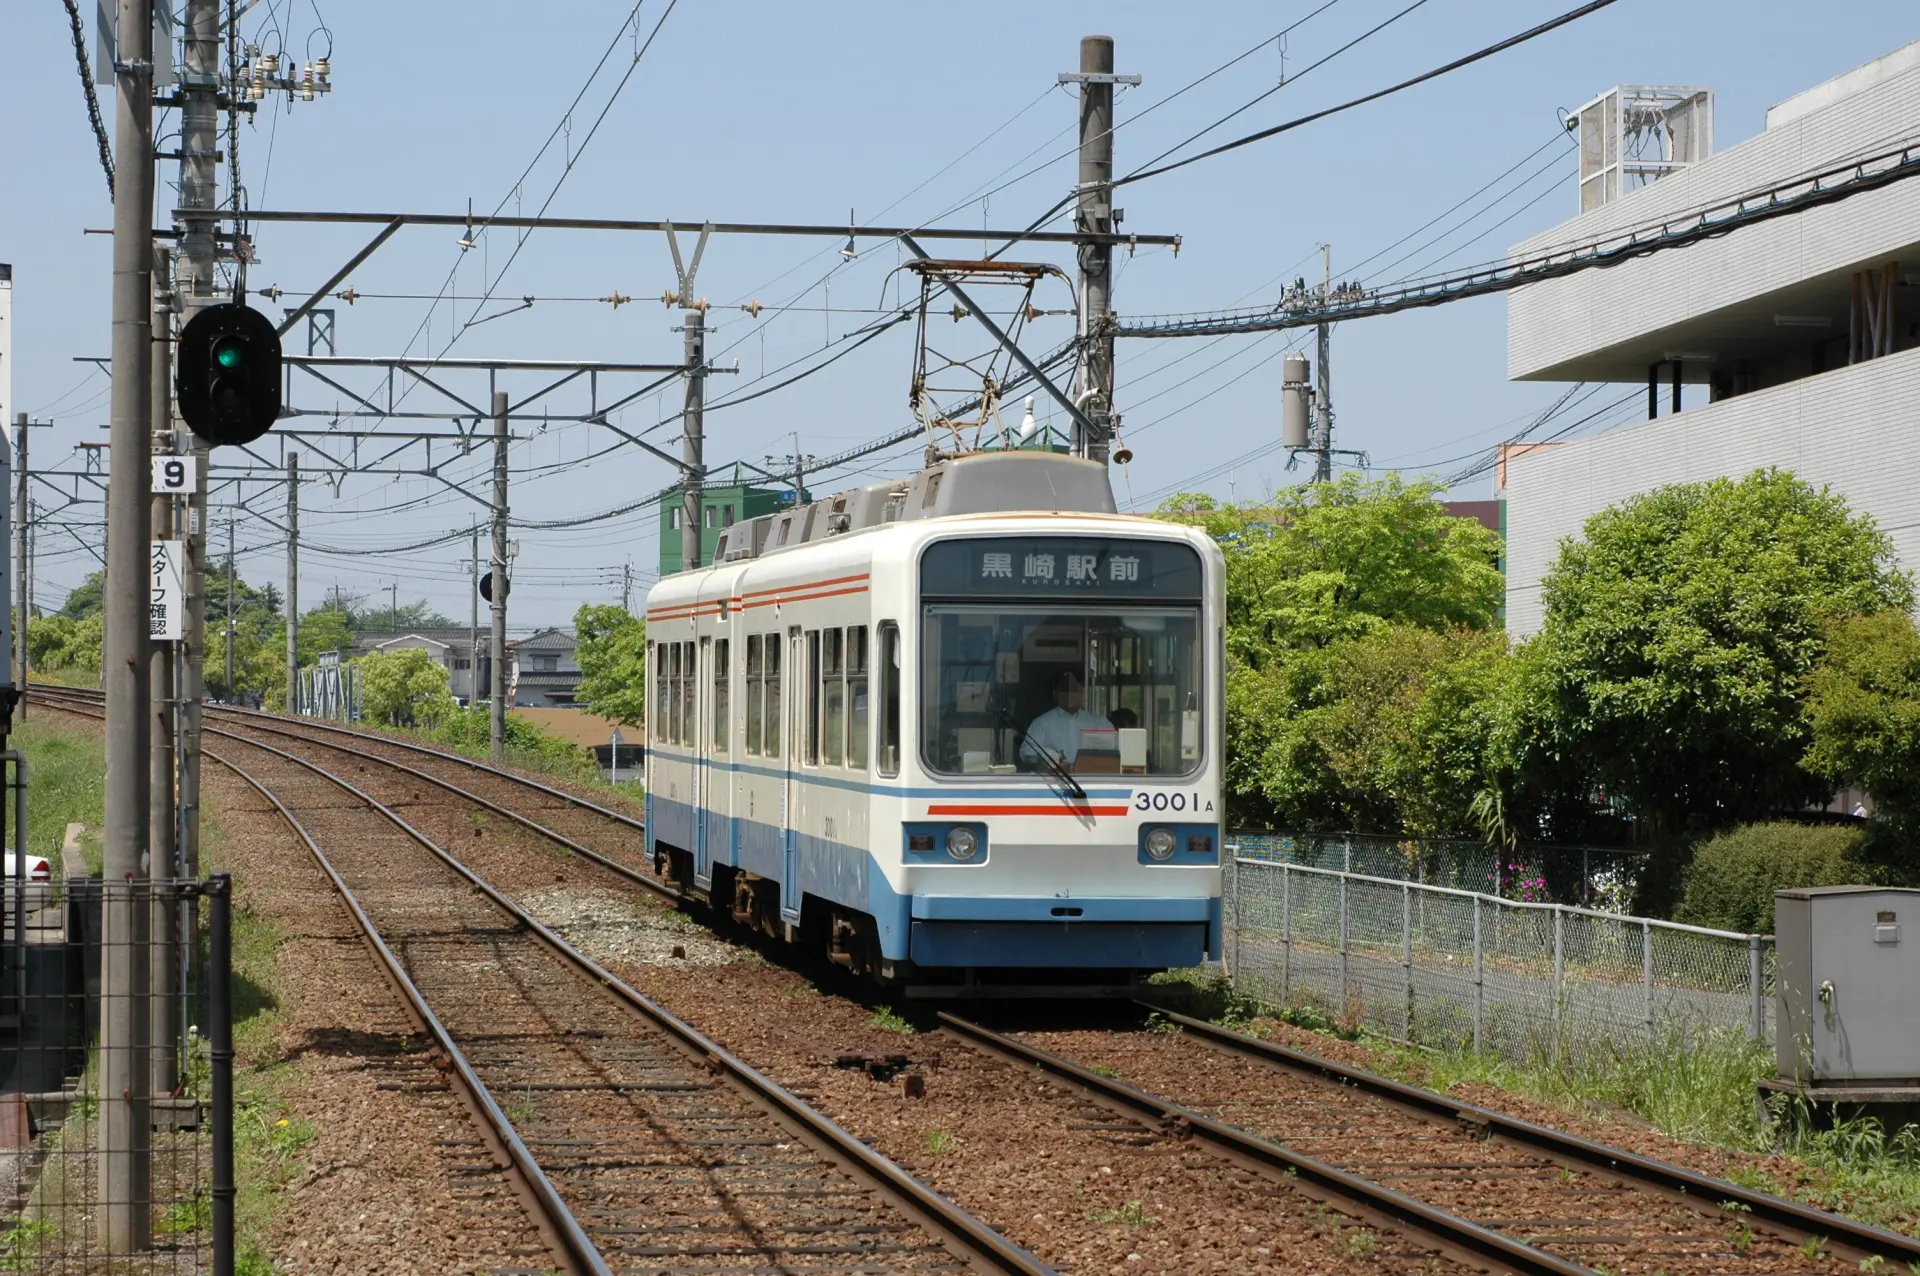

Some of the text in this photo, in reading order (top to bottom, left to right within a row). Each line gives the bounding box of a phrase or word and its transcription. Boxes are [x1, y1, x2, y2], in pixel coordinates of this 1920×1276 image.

[164, 460, 185, 488] 9
[982, 553, 1140, 581] 黒崎駅前
[150, 544, 167, 635] スターフ確認
